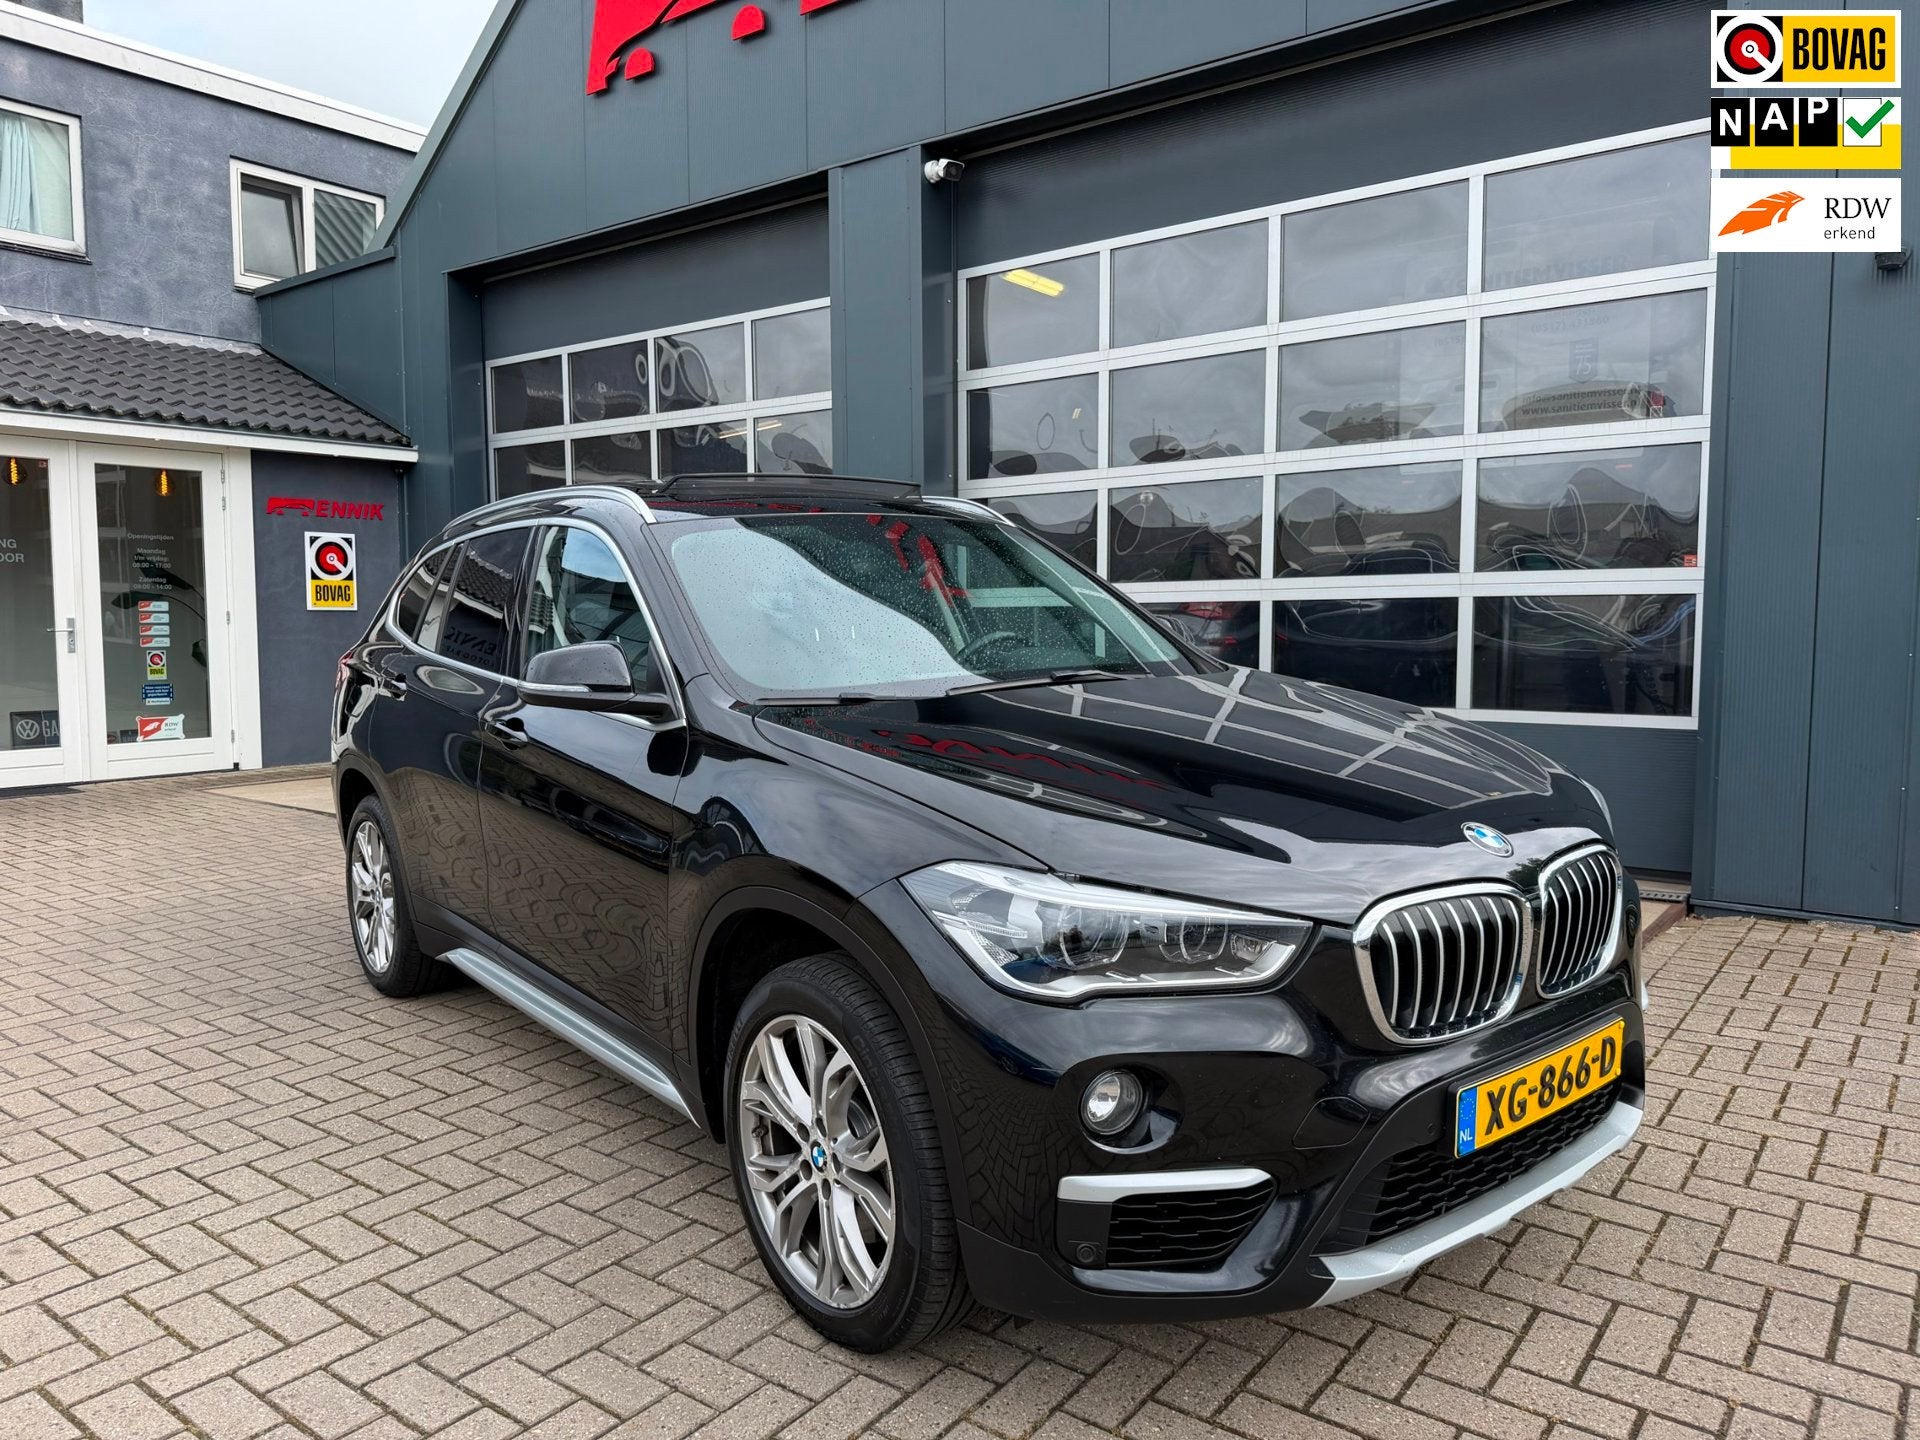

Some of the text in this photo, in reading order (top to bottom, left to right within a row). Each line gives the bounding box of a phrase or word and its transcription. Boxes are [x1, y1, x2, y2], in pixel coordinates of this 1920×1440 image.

[315, 584, 351, 602] BOVAG
[1484, 1036, 1616, 1136] XG-866-D
[1459, 1128, 1473, 1144] NL
